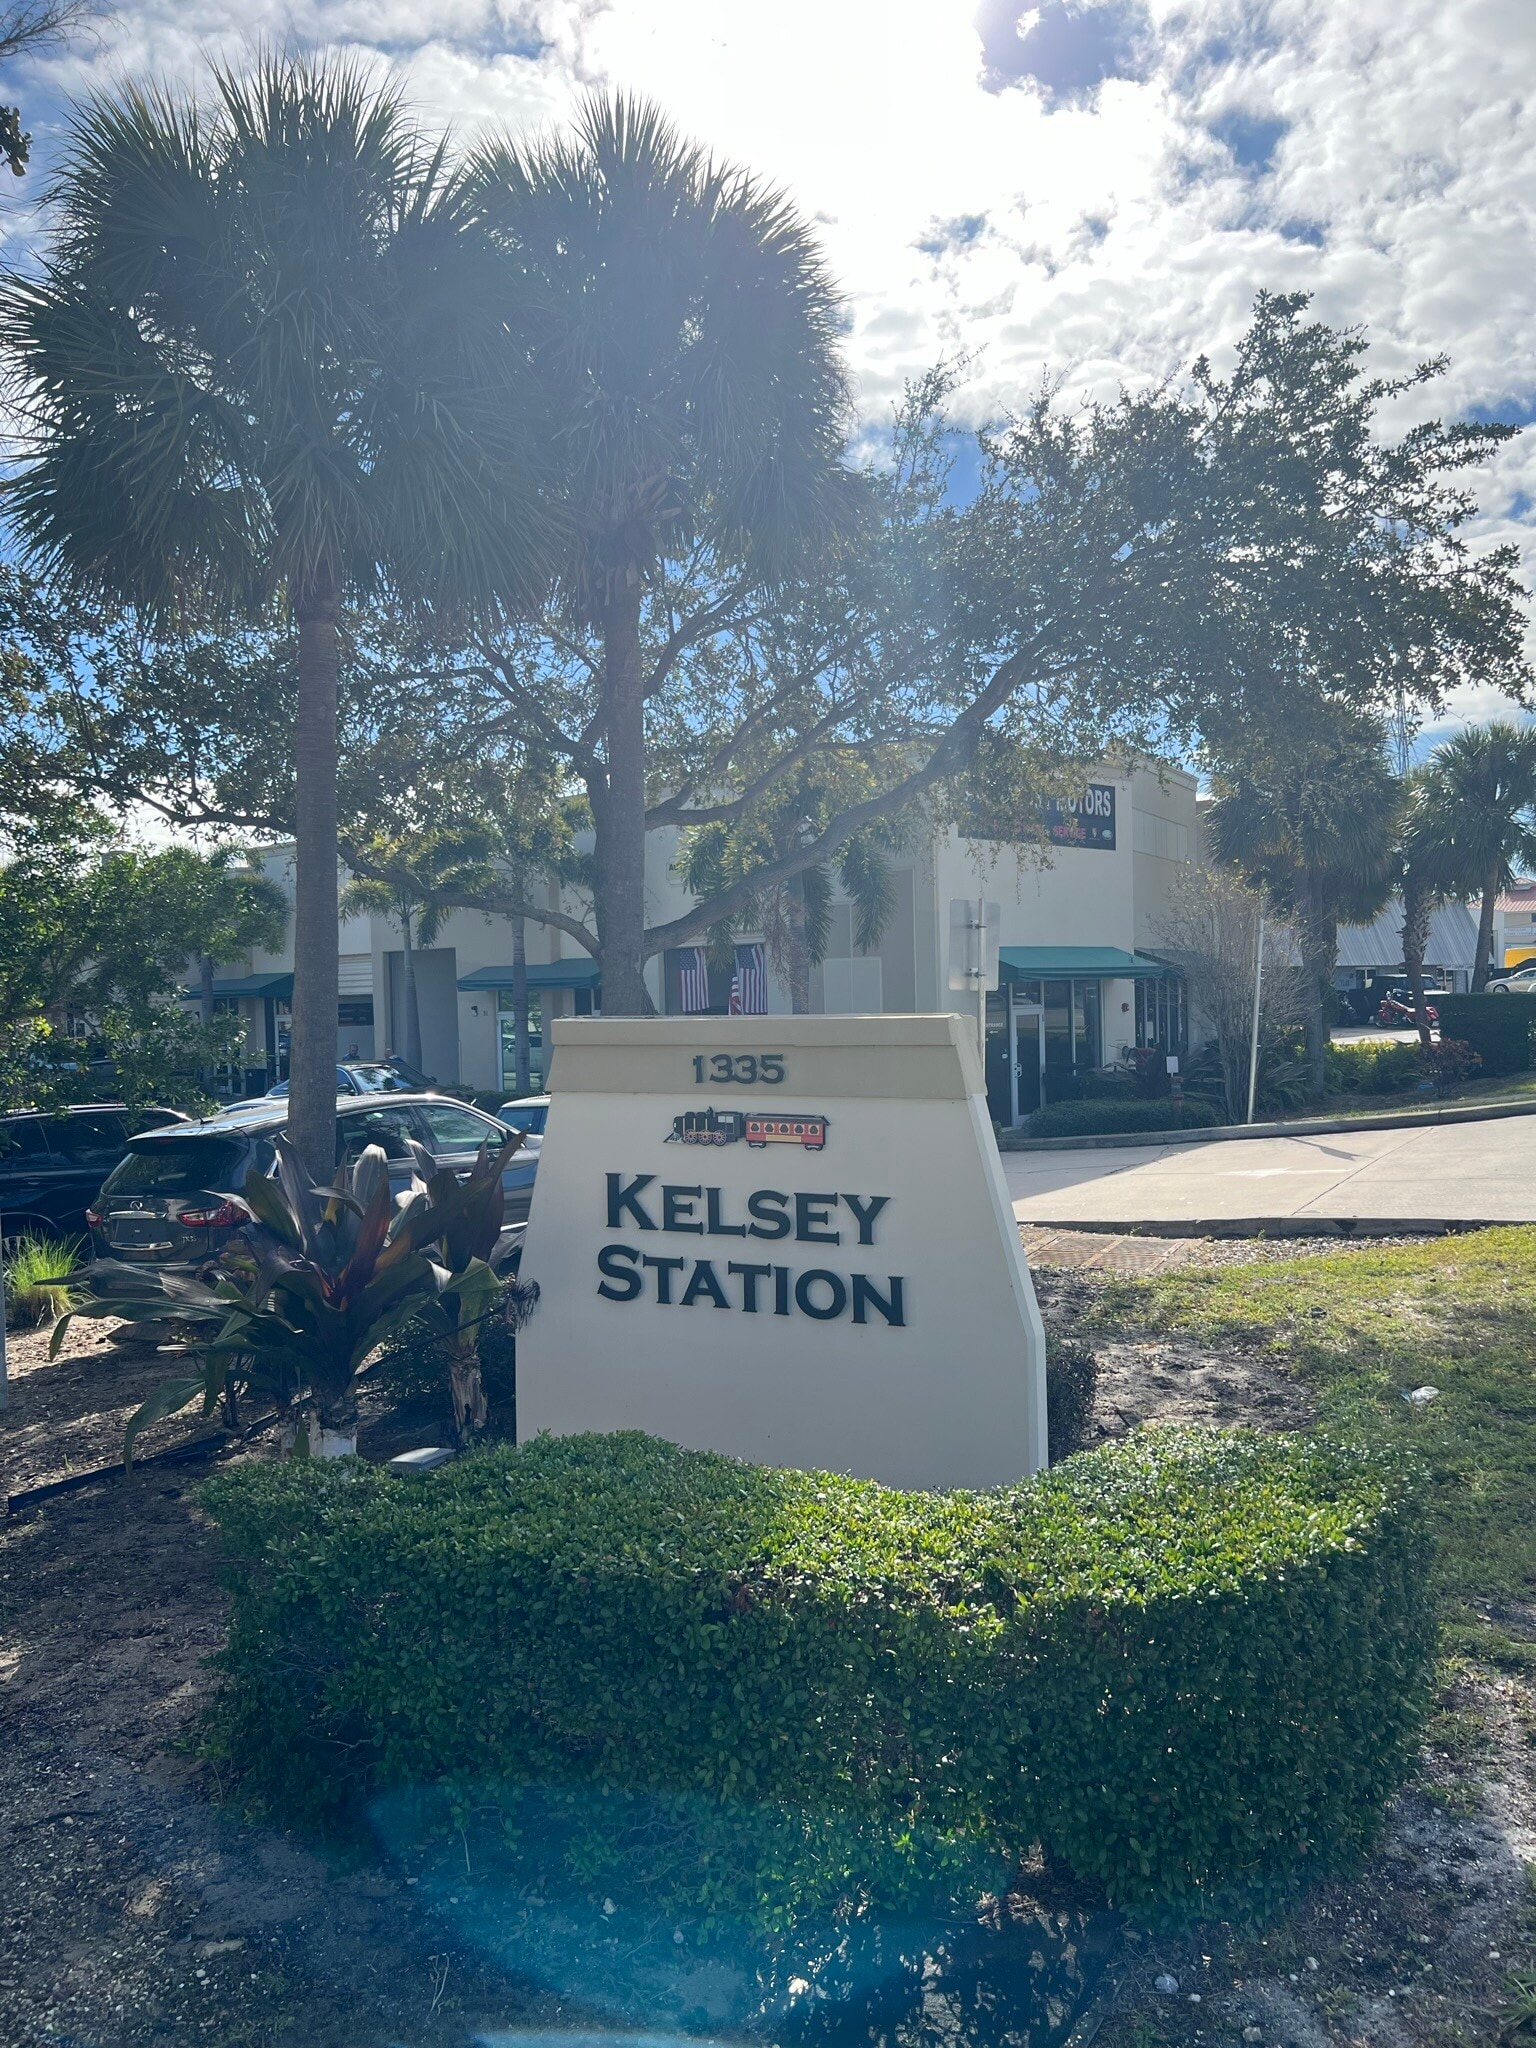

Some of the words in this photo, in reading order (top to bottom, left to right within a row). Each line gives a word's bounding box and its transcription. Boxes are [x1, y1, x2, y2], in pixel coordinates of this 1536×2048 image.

[1056, 788, 1111, 817] OORS
[1053, 825, 1087, 840] SERVCE
[693, 1054, 786, 1085] 1335
[605, 1172, 891, 1247] KELSEY
[597, 1244, 908, 1328] STATION
